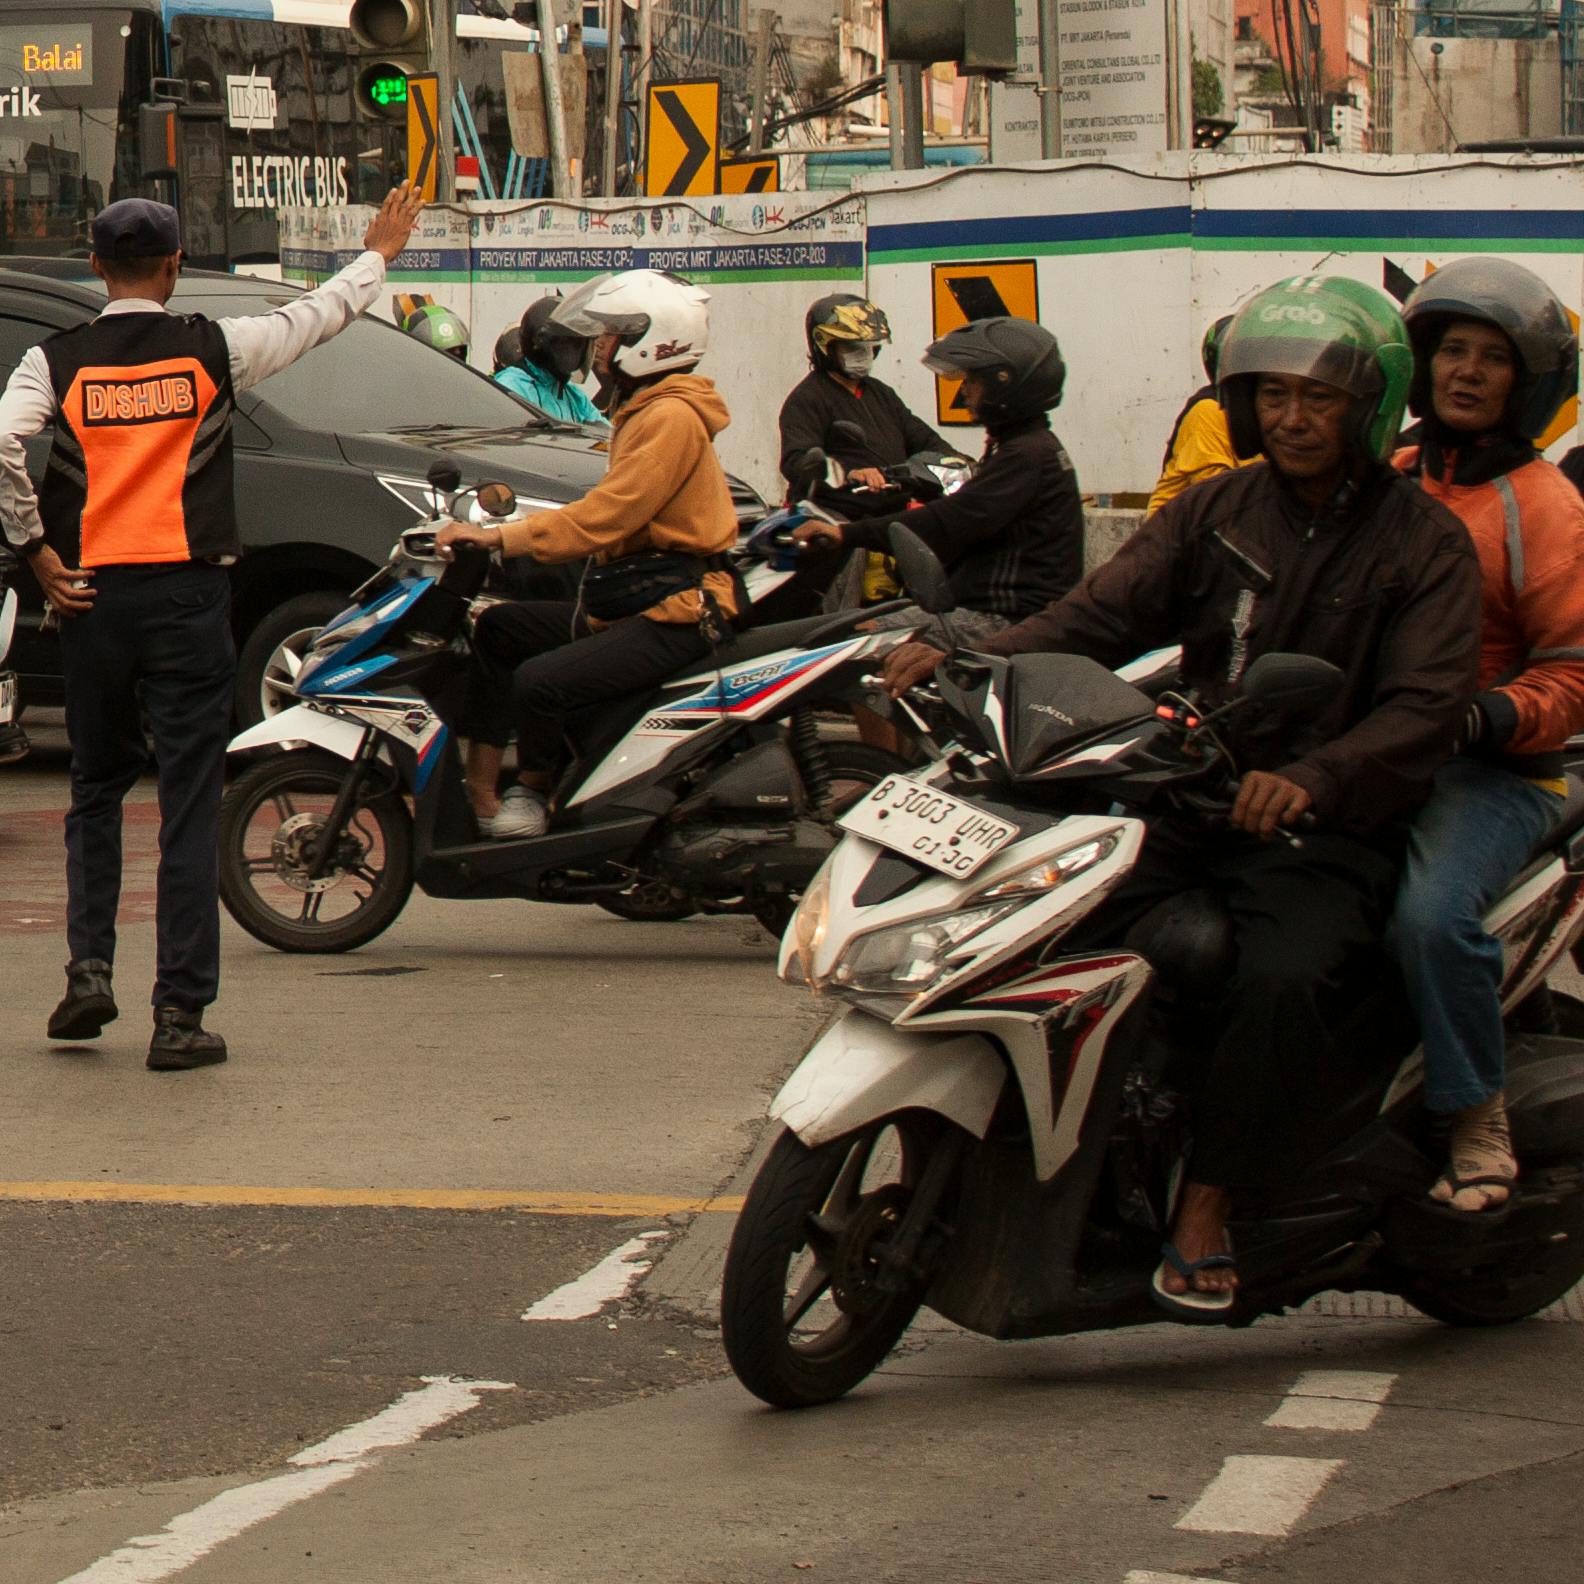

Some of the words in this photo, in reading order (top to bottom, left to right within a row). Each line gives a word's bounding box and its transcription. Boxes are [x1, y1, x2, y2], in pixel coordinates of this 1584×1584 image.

[23, 43, 83, 73] Balai
[232, 155, 313, 208] ELECTRIC
[315, 156, 348, 207] BUS
[480, 251, 516, 268] PROYEK
[517, 251, 537, 267] MRT
[539, 250, 579, 267] JAKARTA
[580, 250, 612, 267] FASE-2
[648, 251, 689, 269] PROYEK
[690, 250, 712, 268] MRT
[714, 249, 757, 267] JAKARTA
[758, 247, 792, 266] FASE-2
[793, 246, 826, 265] CP-203
[1261, 302, 1327, 326] Grab
[86, 377, 194, 421] DISHUB
[324, 666, 365, 688] HONDA
[1027, 702, 1075, 727] HONDA
[871, 780, 896, 801] B
[956, 815, 1008, 849] UHR
